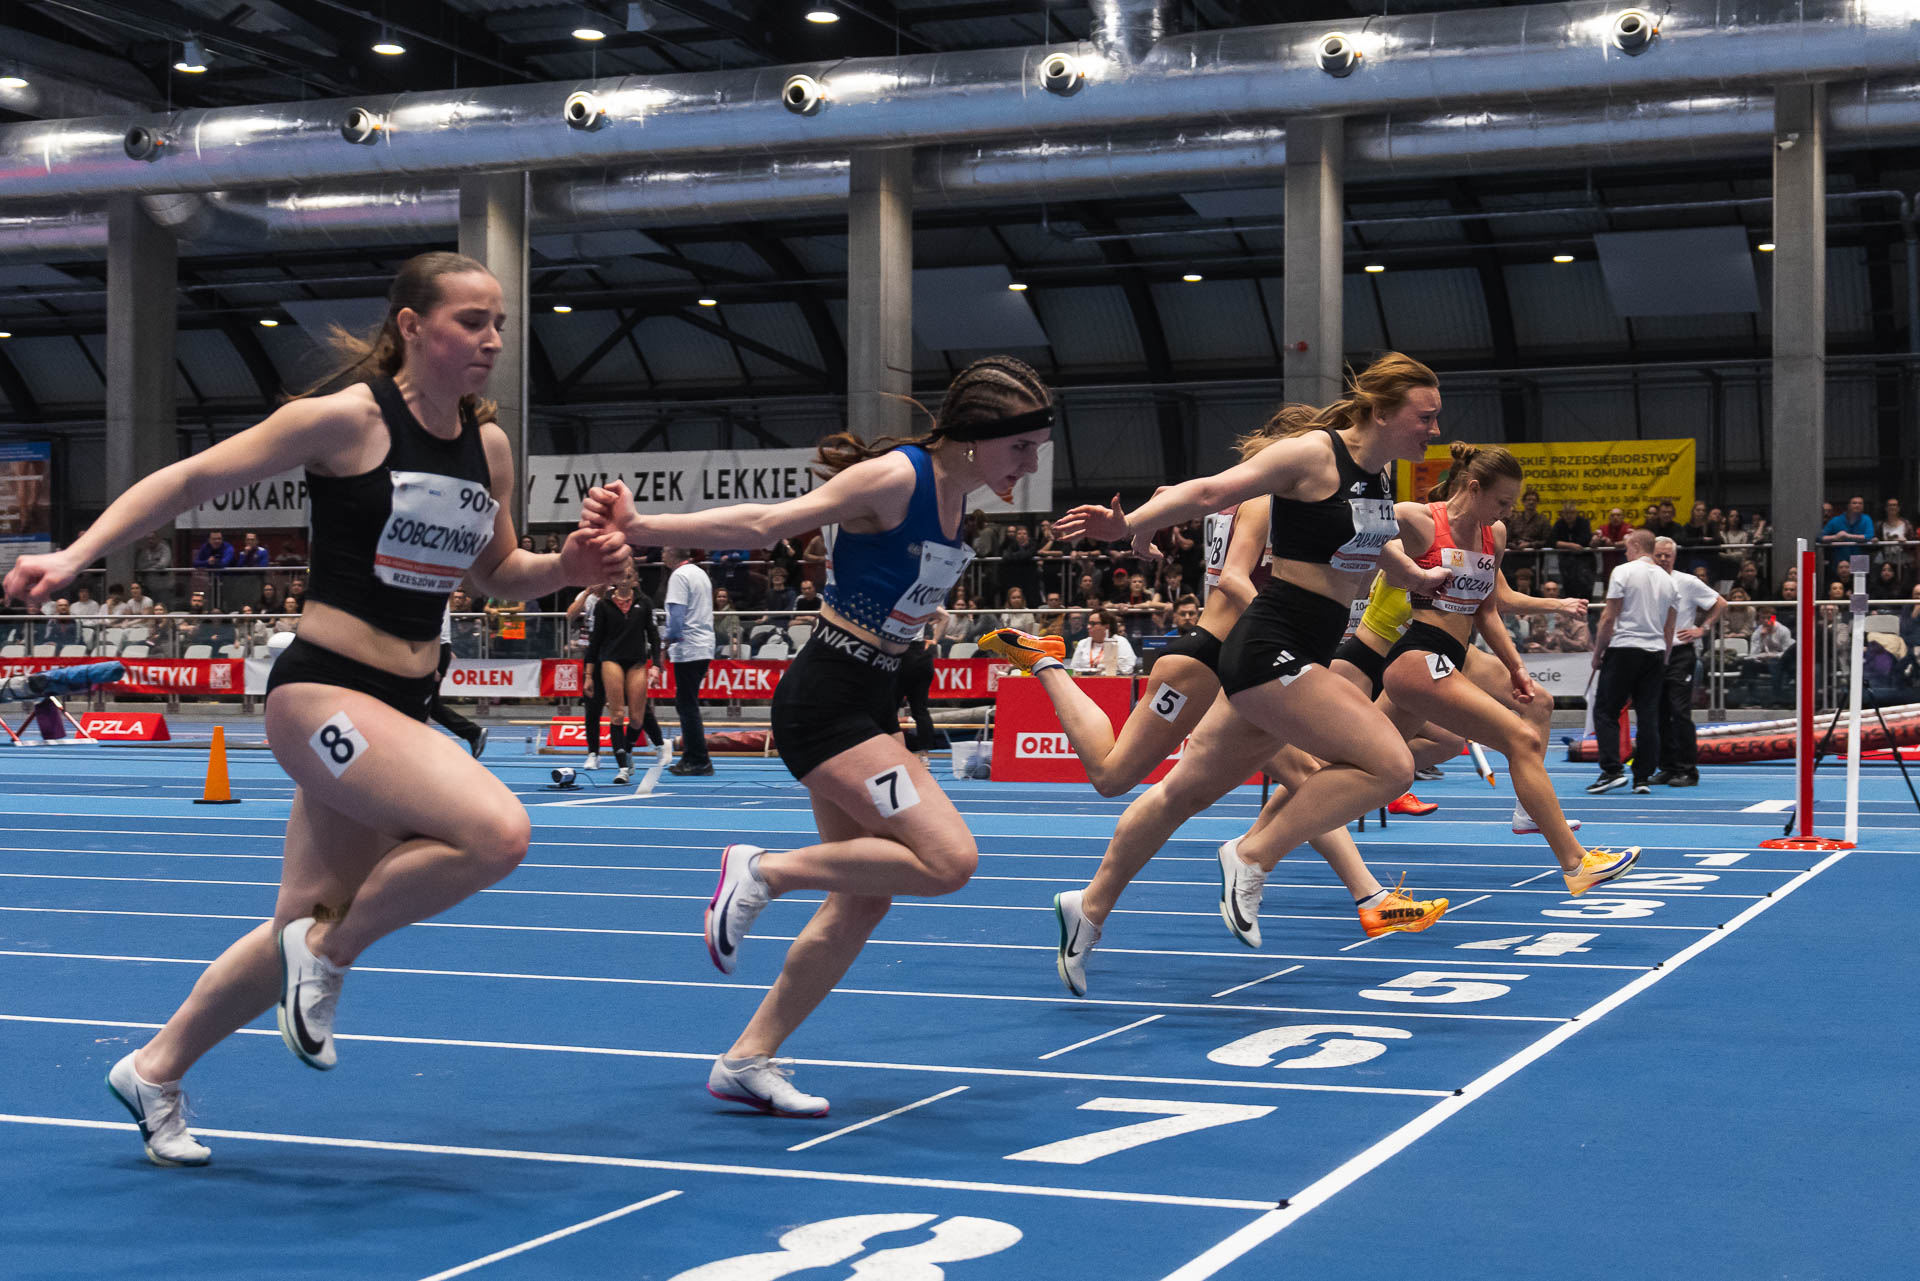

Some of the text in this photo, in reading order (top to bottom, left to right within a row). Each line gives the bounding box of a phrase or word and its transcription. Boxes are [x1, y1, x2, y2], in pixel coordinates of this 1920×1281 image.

[1517, 453, 1679, 466] SKIE PRZEDSIĘBIORSTWO
[1583, 467, 1670, 478] KOMUNALNEJ
[554, 471, 684, 504] ZWIZEK
[703, 467, 813, 500] LEKKIEJ
[1350, 481, 1368, 495] 4F
[199, 481, 309, 511] ODKARP
[1477, 557, 1495, 571] 66
[393, 573, 436, 588] RZESZÓW
[1450, 574, 1493, 593] KÓRZAK
[818, 626, 900, 672] NIKE PRO
[1435, 655, 1449, 674] 4
[452, 669, 514, 686] ORLEN
[1156, 690, 1180, 715] 5
[87, 720, 144, 735] PZLA
[320, 724, 355, 764] 8
[875, 771, 899, 810] 7
[1683, 853, 1751, 866] 1
[1601, 873, 1720, 890] 2
[1381, 908, 1424, 920] NITRO
[1541, 899, 1666, 919] 3
[1453, 932, 1601, 956] 4
[1358, 971, 1530, 1003] 5
[1206, 1025, 1413, 1069] 6
[1002, 1097, 1278, 1164] 7
[667, 1213, 1023, 1281] 8
